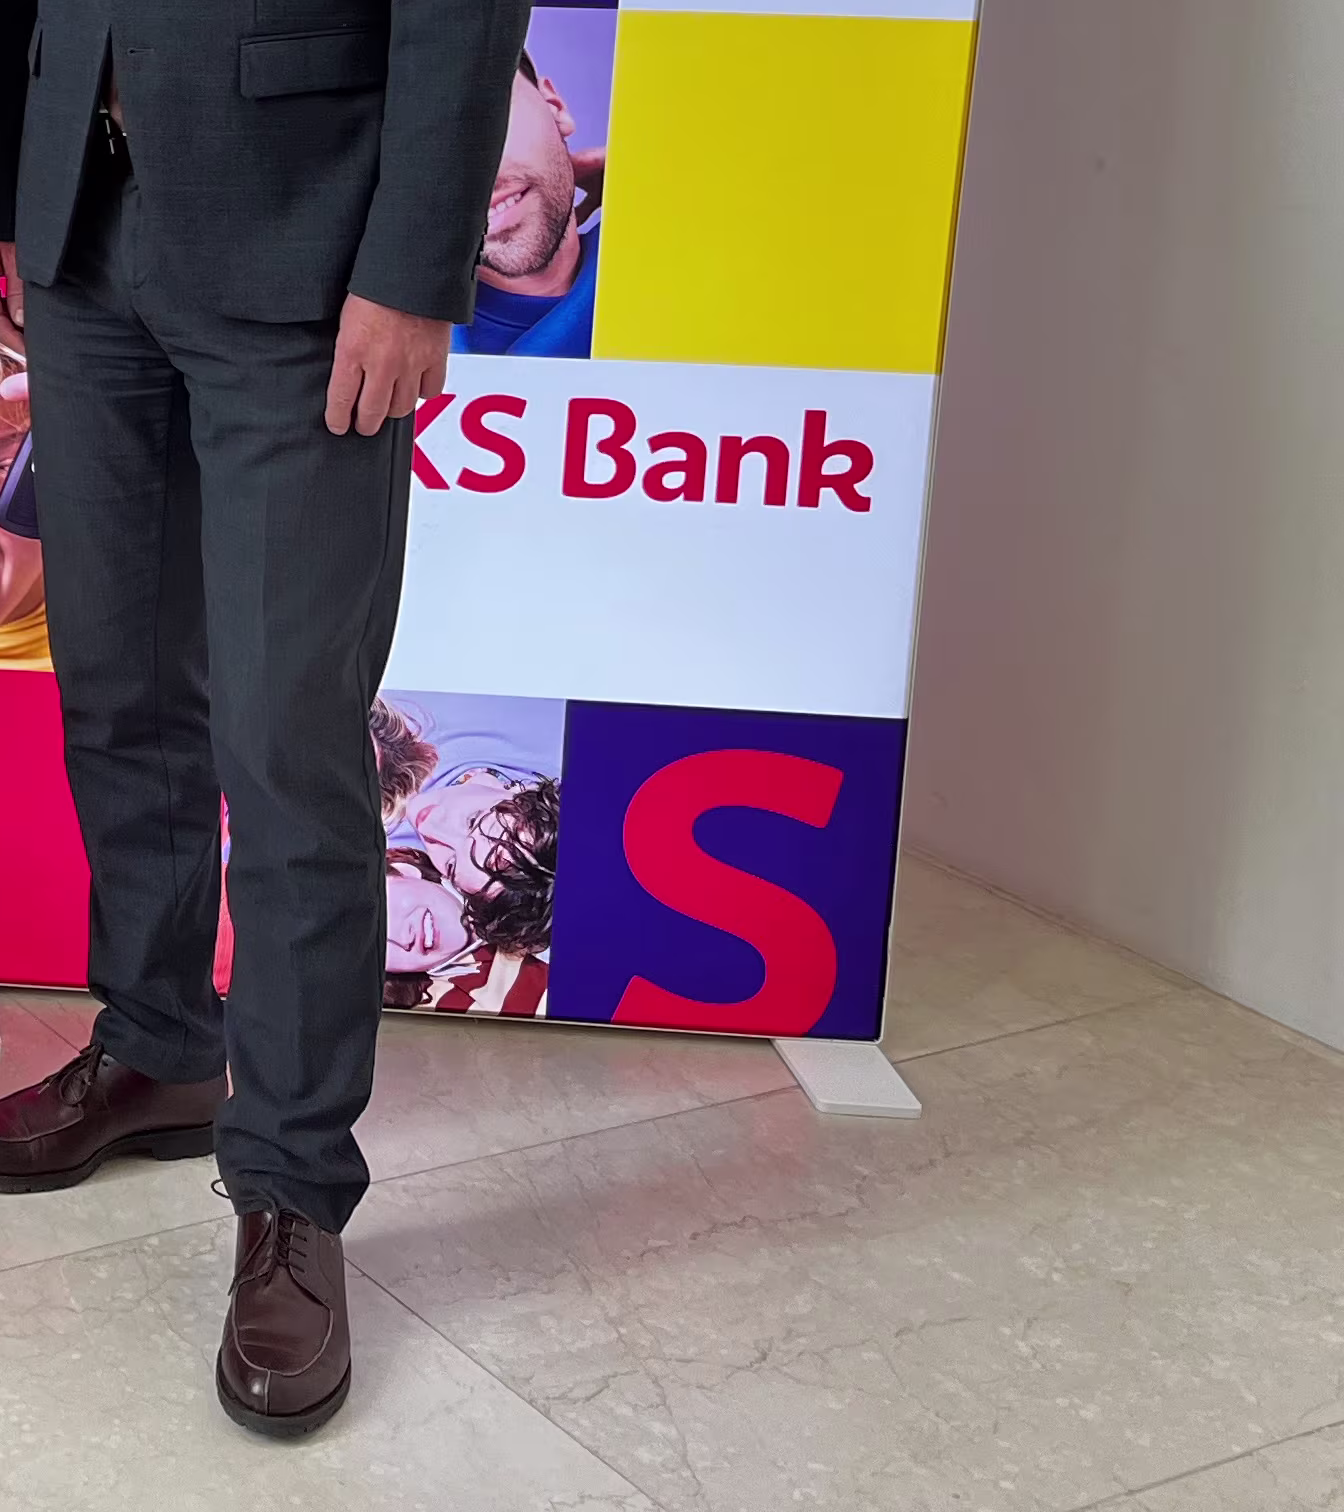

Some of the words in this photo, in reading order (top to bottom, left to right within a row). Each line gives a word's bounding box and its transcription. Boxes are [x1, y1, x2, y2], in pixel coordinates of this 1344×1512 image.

[412, 393, 528, 494] KS
[562, 396, 875, 514] Bank
[610, 748, 844, 1038] S
